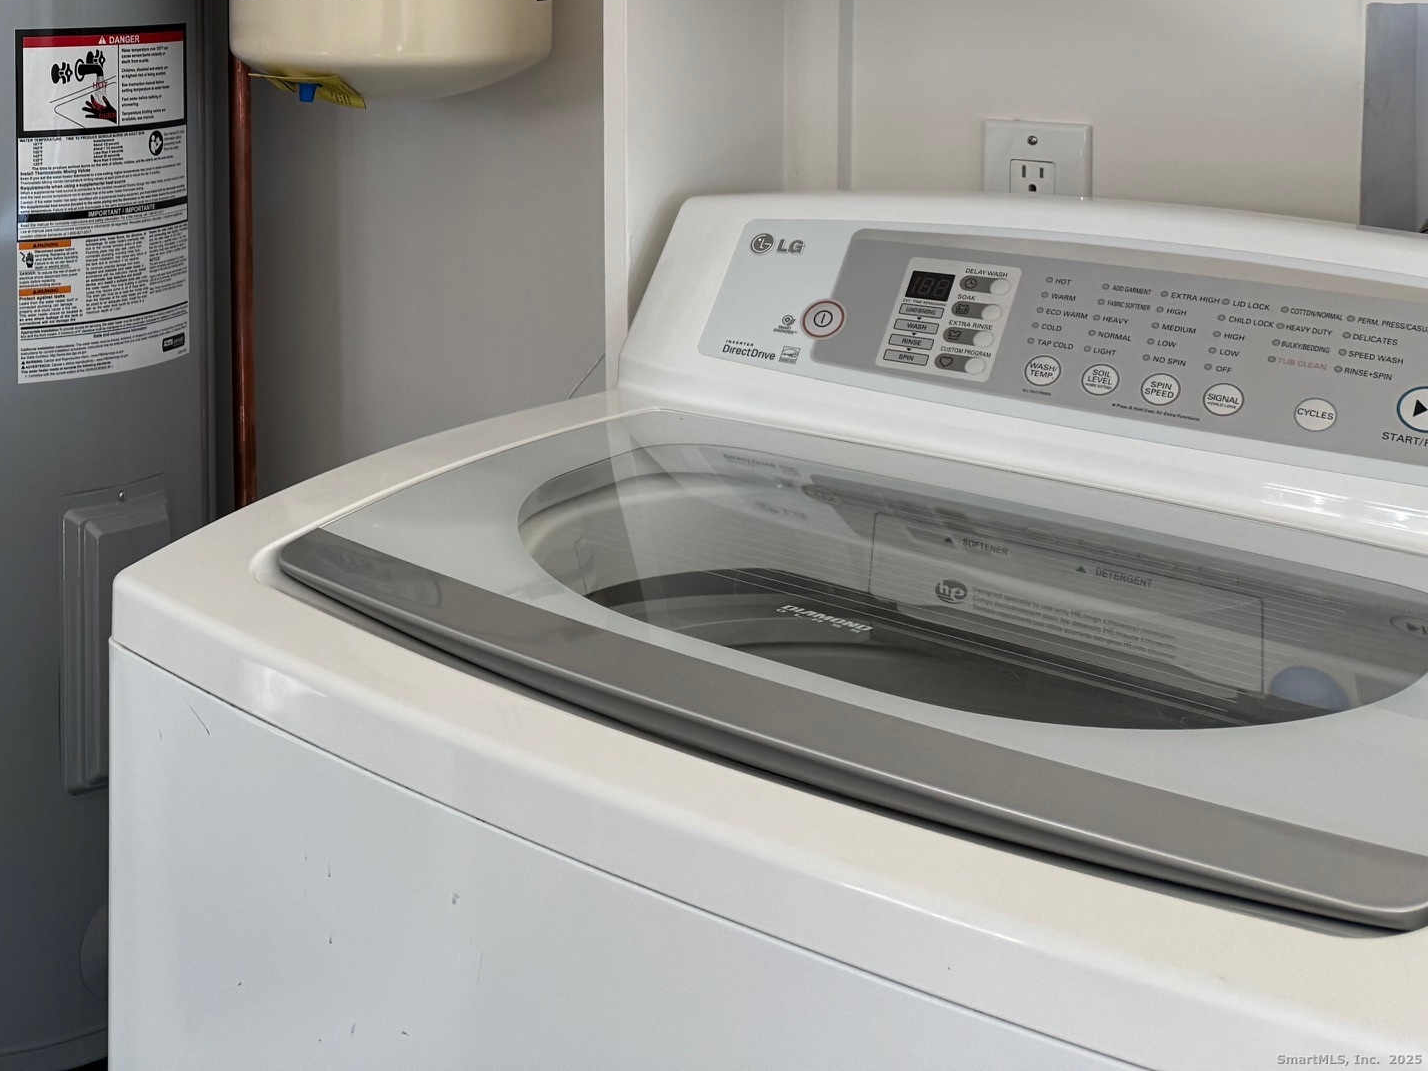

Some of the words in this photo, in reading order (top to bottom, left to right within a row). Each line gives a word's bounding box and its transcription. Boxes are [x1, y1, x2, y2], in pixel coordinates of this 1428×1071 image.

[109, 35, 140, 45] DANGER
[88, 208, 121, 218] IMPORTANT
[125, 204, 155, 214] IMPORTANTE
[776, 238, 805, 255] LG
[987, 270, 1008, 278] WASH
[1124, 286, 1152, 295] GARMENT
[957, 293, 976, 301] SOAK
[1051, 293, 1077, 301] WARM
[1170, 292, 1198, 302] EXTRA
[1199, 295, 1221, 304] HIGH
[1107, 300, 1124, 308] FABRIC
[1124, 302, 1151, 311] SOFTENER
[1232, 300, 1246, 308] LID
[1247, 302, 1271, 311] LOCK
[918, 308, 936, 316] SENSING
[1045, 308, 1062, 316] ECO
[1063, 311, 1088, 320] WARM
[1166, 307, 1187, 316] HIGH
[1290, 308, 1343, 321] COTTON/NORMAL
[948, 320, 971, 328] EXTRA
[972, 322, 993, 330] RINSE
[1102, 316, 1130, 325] HEAVY
[1228, 316, 1251, 325] CHILD
[1253, 319, 1275, 328] LOCK
[1357, 317, 1379, 327] PERM.
[1381, 320, 1428, 334] PRESS/CASU
[906, 322, 927, 331] WASH
[1041, 323, 1062, 332] COLD
[1162, 323, 1197, 334] MEDIUM
[1285, 323, 1311, 333] HEAVY
[1312, 327, 1333, 336] DUTY
[901, 337, 923, 346] RINSE
[1097, 331, 1132, 342] NORMAL
[1223, 332, 1246, 342] HIGH
[1352, 333, 1399, 346] DELICATES
[725, 339, 754, 347] INVERTER
[1037, 338, 1052, 346] TAP
[1053, 341, 1074, 350] COLD
[1157, 339, 1177, 348] LOW
[1281, 340, 1331, 354] BULKY/BEDDING
[898, 353, 915, 361] SPIN
[940, 345, 964, 355] CUSTOM
[964, 349, 992, 358] PROGRAM
[1093, 347, 1117, 356] LIGHT
[1219, 348, 1240, 357] LOW
[1152, 355, 1166, 364] NO
[1166, 357, 1187, 367] SPIN
[1348, 350, 1376, 361] SPEED
[1377, 354, 1404, 365] WASH
[1029, 362, 1059, 372] WASH/
[1277, 356, 1295, 365] TUB
[1297, 360, 1327, 371] CLEAN
[1030, 369, 1055, 379] TEMP.
[1092, 368, 1112, 378] SOIL
[1215, 365, 1233, 374] OFF
[1343, 367, 1393, 381] RINSE+SPIN
[1087, 375, 1113, 385] LEVEL
[1150, 380, 1173, 390] SPIN
[1144, 387, 1175, 399] SPEED
[1206, 393, 1240, 405] SIGNAL
[1296, 407, 1335, 421] CYCLES
[962, 538, 1008, 556] SOFTENER
[1095, 566, 1153, 589] DETERGENT
[781, 604, 873, 632] DIAMOND
